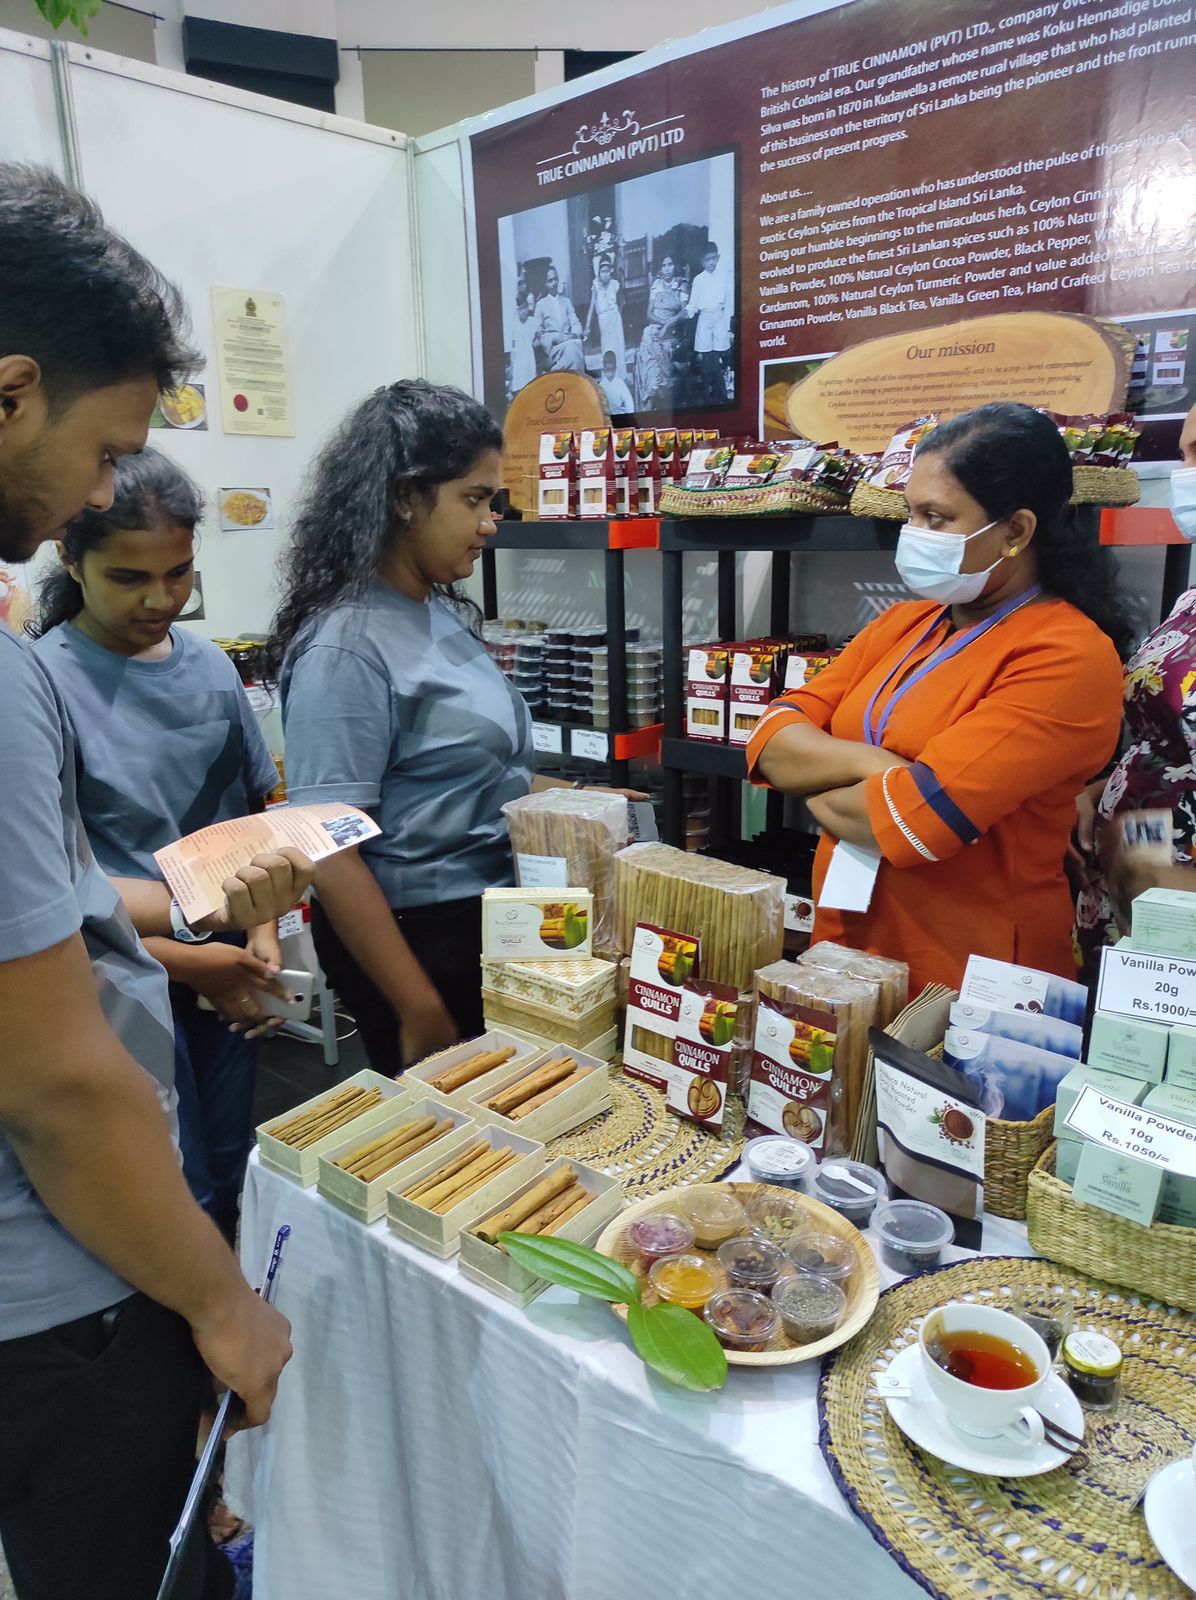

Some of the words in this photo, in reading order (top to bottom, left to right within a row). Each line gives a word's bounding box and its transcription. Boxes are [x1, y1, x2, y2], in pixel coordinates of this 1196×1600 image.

[760, 87, 779, 98] The
[781, 76, 817, 93] history
[832, 60, 860, 78] TRUE
[862, 40, 927, 69] CINNAMON
[930, 30, 962, 51] (PVT)
[966, 22, 995, 39] LTD.,
[998, 3, 1059, 29] company
[760, 101, 790, 117] British
[792, 87, 832, 108] Colonial
[834, 86, 853, 97] era.
[855, 78, 875, 91] Our
[877, 59, 940, 88] grandfather
[941, 48, 979, 67] whose
[980, 38, 1015, 56] name
[1016, 30, 1040, 45] was
[1042, 20, 1074, 38] Koku
[1077, 0, 1150, 31] Hennadige
[760, 123, 781, 136] Silva
[782, 118, 801, 130] was
[802, 112, 824, 125] born
[838, 100, 862, 115] 1870
[874, 82, 928, 106] Kudawella
[938, 70, 979, 89] remote
[980, 59, 1007, 77] rural
[1009, 50, 1048, 69] village
[1051, 40, 1077, 57] that
[1078, 32, 1107, 50] who
[1110, 24, 1135, 42] had
[1138, 9, 1191, 37] planted
[770, 139, 788, 151] this
[789, 130, 829, 147] business
[844, 121, 862, 133] the
[862, 110, 905, 128] territory
[918, 100, 933, 114] Sri
[934, 93, 967, 110] Lanka
[968, 85, 1002, 101] being
[1004, 79, 1024, 92] the
[1026, 65, 1074, 89] pioneer
[1075, 57, 1100, 73] and
[1104, 50, 1125, 68] the
[1128, 41, 1162, 62] front
[537, 165, 564, 186] TRUE
[565, 149, 625, 177] CINNAMON
[627, 135, 658, 161] (PVT)
[661, 127, 685, 148] LTD
[760, 161, 775, 172] the
[776, 153, 811, 168] success
[823, 140, 861, 160] present
[862, 130, 908, 151] progress.
[759, 215, 774, 226] We
[775, 214, 789, 224] are
[797, 204, 826, 219] family
[826, 196, 860, 213] owned
[861, 188, 910, 207] operation
[911, 182, 935, 195] who
[936, 179, 955, 190] has
[956, 161, 1022, 186] understood
[1023, 159, 1044, 172] the
[1045, 151, 1078, 171] pulse
[759, 190, 788, 204] About
[759, 231, 786, 244] exotic
[787, 225, 819, 239] Ceylon
[820, 219, 851, 234] Spices
[852, 215, 876, 226] from
[877, 210, 895, 222] the
[895, 200, 936, 218] Tropical
[938, 193, 970, 210] Island
[972, 190, 987, 203] Sri
[989, 184, 1026, 200] Lanka.
[759, 249, 789, 262] Owing
[790, 246, 807, 256] our
[808, 238, 845, 253] humble
[846, 228, 901, 247] beginnings
[916, 221, 934, 233] the
[936, 210, 996, 230] miraculous
[998, 203, 1027, 218] herb,
[1029, 196, 1070, 212] Ceylon
[759, 264, 794, 279] evolved
[807, 257, 847, 273] produce
[848, 253, 865, 264] the
[866, 248, 894, 261] finest
[896, 243, 910, 256] Sri
[912, 239, 949, 253] Lankan
[952, 232, 985, 248] spices
[987, 225, 1014, 240] such
[1033, 216, 1065, 232] 100%
[759, 283, 788, 296] Vanilla
[790, 278, 826, 292] Powder,
[829, 272, 855, 285] 100%
[857, 265, 893, 281] Natural
[895, 261, 930, 276] Ceylon
[932, 256, 965, 269] Cocoa
[968, 247, 1012, 263] Powder,
[1014, 240, 1044, 255] Black
[1047, 234, 1091, 251] Pepper,
[759, 299, 810, 314] Cardamom,
[813, 293, 839, 305] 100%
[841, 286, 876, 302] Natural
[879, 282, 913, 297] Ceylon
[915, 274, 962, 290] Turmeric
[964, 267, 1006, 283] Powder
[1009, 261, 1032, 276] and
[1035, 258, 1067, 272] value
[759, 317, 805, 331] Cinnamon
[807, 311, 843, 324] Powder,
[845, 305, 877, 319] Vanilla
[879, 301, 906, 314] Black
[907, 299, 927, 310] Tea,
[929, 292, 964, 307] Vanilla
[966, 289, 999, 302] Green
[1001, 285, 1024, 296] Tea,
[1027, 277, 1058, 293] Hand
[1061, 271, 1105, 288] Crafted
[759, 335, 787, 348] world.
[906, 344, 935, 361] Our
[937, 340, 996, 357] mission
[695, 689, 716, 697] QUILLS
[738, 694, 760, 702] QUILLS
[1121, 955, 1164, 972] Vanilla
[634, 983, 680, 1008] CINNAMON
[1155, 981, 1179, 997] 20g
[640, 996, 673, 1015] QUILLS
[1132, 998, 1196, 1017] Rs.1900/=
[675, 1040, 720, 1065] CINNAMON
[678, 1053, 711, 1073] QUILLS
[761, 1059, 819, 1092] CINNAMON
[768, 1073, 808, 1100] QUILLS
[901, 1081, 928, 1100] Natural
[1099, 1096, 1143, 1122] Vanilla
[1102, 1130, 1170, 1163] Rs.1050/=
[1130, 1128, 1154, 1144] 10g
